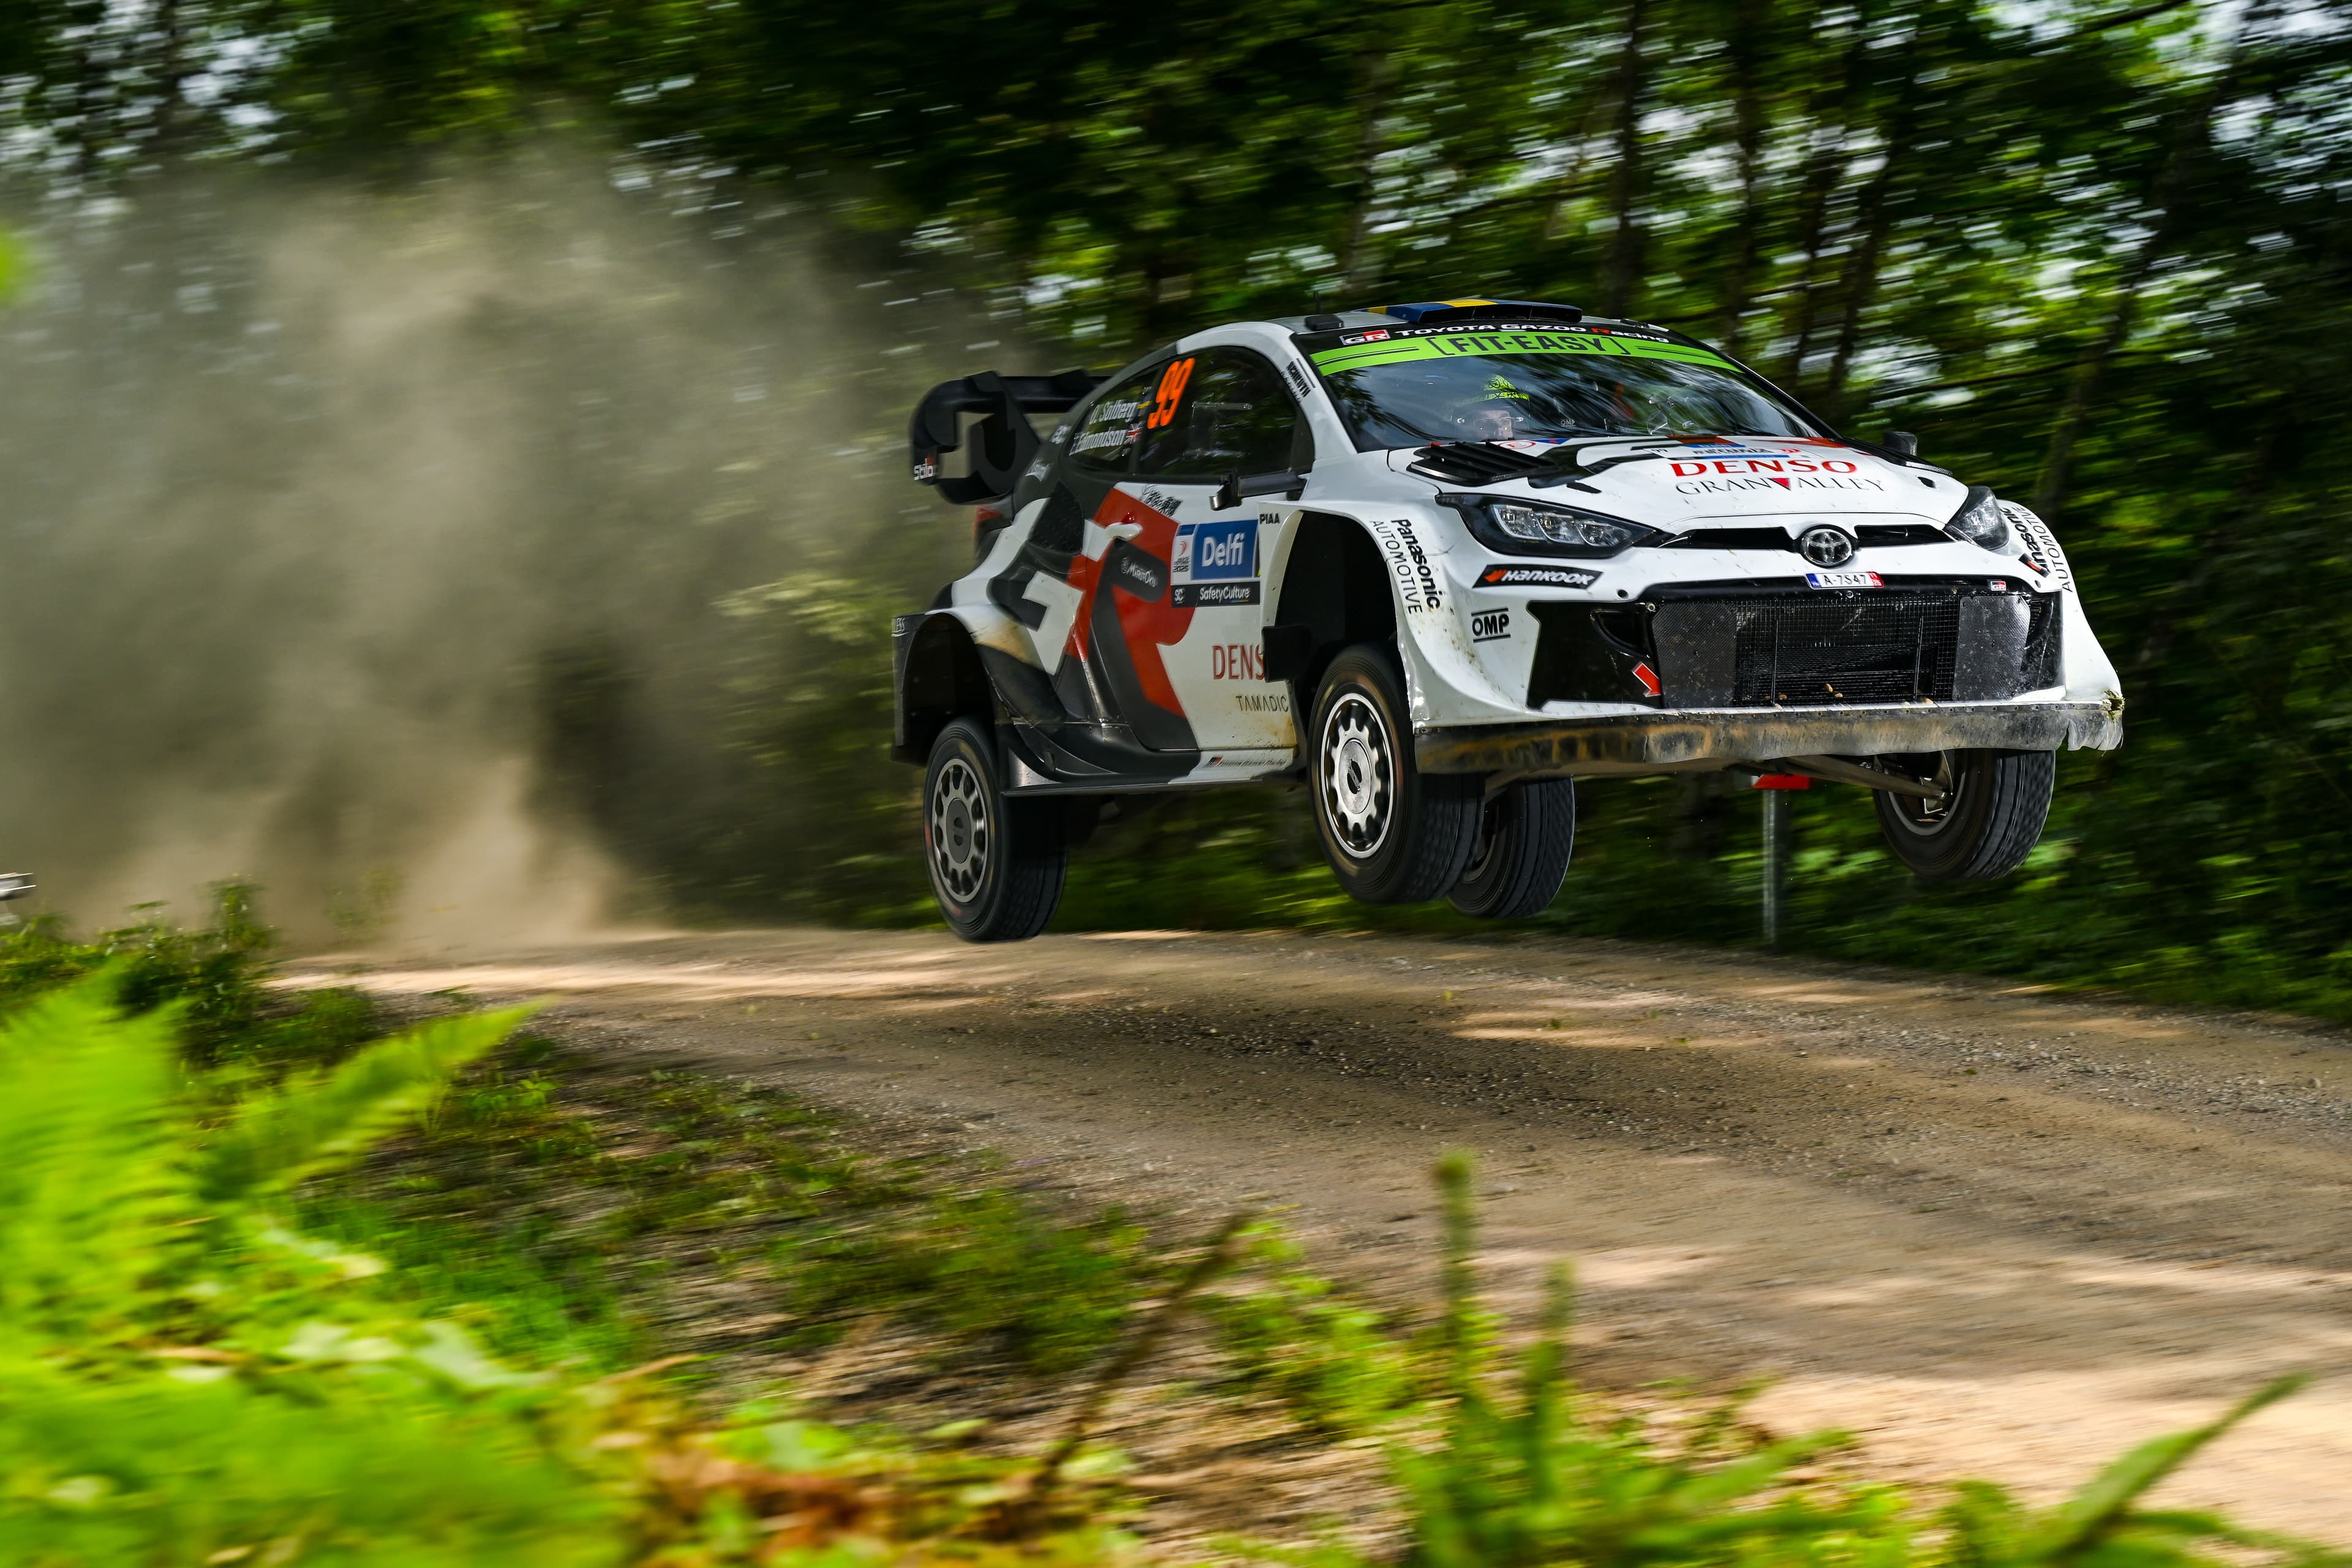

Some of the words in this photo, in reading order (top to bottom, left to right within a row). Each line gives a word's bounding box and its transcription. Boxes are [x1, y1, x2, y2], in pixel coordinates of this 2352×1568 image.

[1344, 333, 1390, 344] GR
[1395, 325, 1496, 336] TOYOTA
[1591, 328, 1669, 343] Racing
[1147, 358, 1195, 429] 99
[1099, 399, 1137, 423] Solberg
[1075, 426, 1128, 453] Edmondson
[1669, 459, 1858, 477] DENSO
[1259, 513, 1280, 524] PIAA
[1201, 532, 1245, 567] Delfi
[2000, 508, 2051, 573] nasonic
[2011, 507, 2073, 593] AUTOMOTIVE
[1370, 521, 1423, 614] AUTOMOTIVE
[1391, 519, 1443, 609] Panasonic
[1174, 588, 1185, 602] SC
[1199, 585, 1251, 603] SafetyCulture
[1472, 614, 1510, 637] OMP
[1212, 643, 1265, 680] DENS
[1235, 695, 1289, 712] TAMADIC
